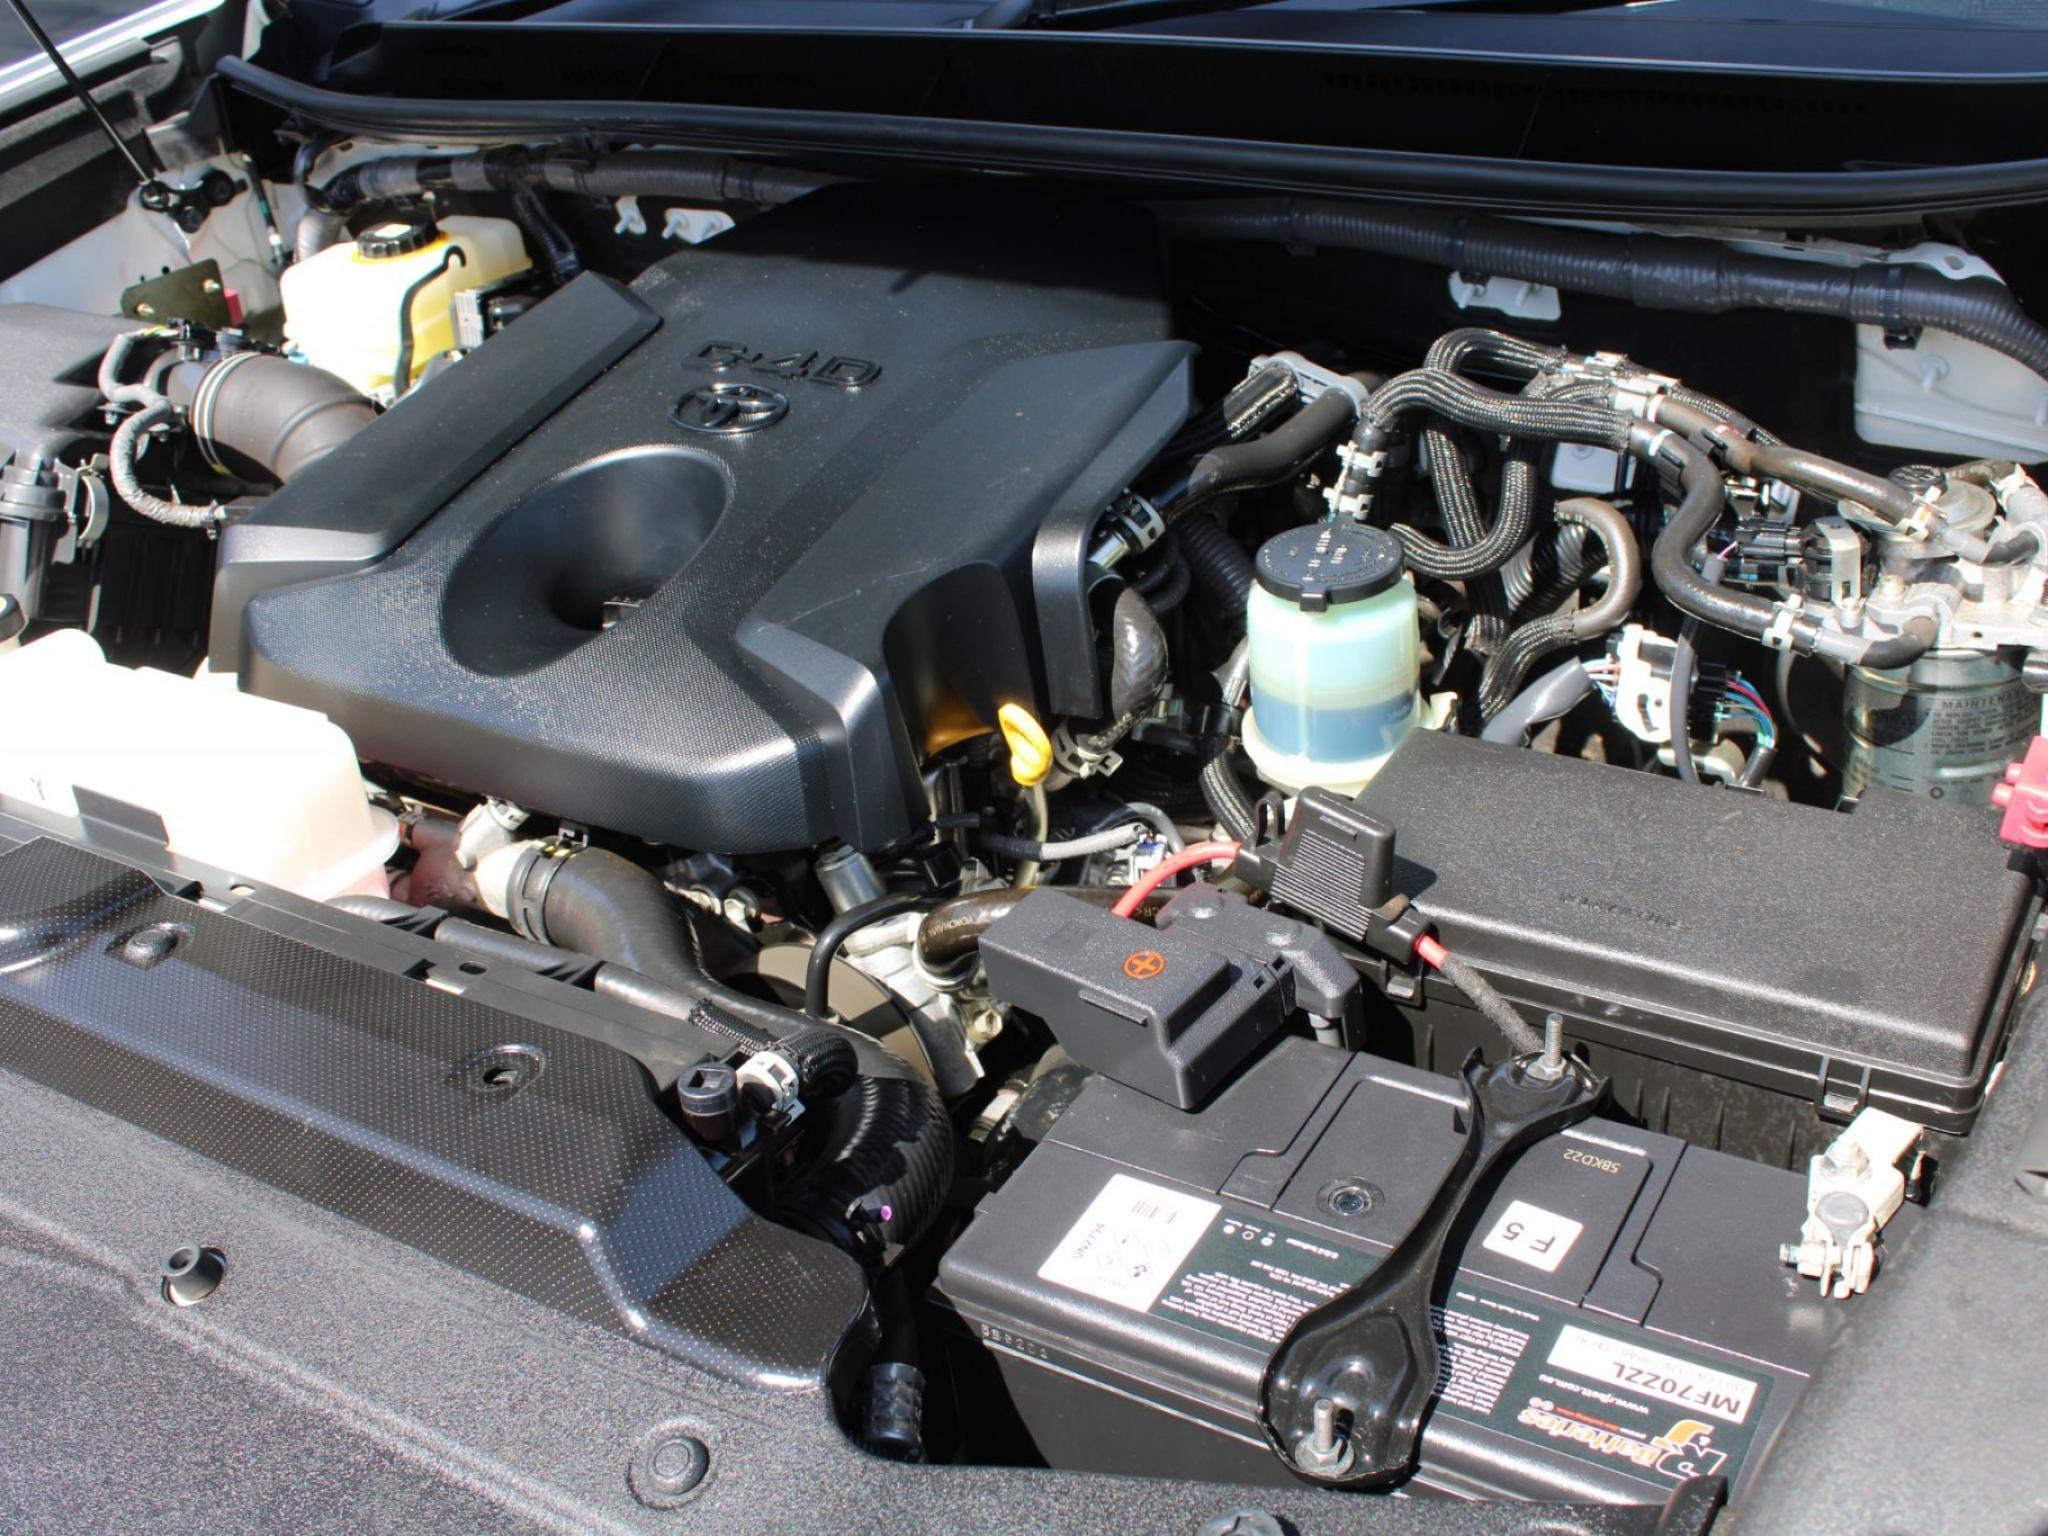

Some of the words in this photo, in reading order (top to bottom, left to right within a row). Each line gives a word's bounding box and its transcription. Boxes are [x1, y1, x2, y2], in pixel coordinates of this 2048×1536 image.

[1502, 1222, 1525, 1241] 5
[1529, 1236, 1556, 1254] F
[1613, 1361, 1741, 1414] MF70ZZL
[1517, 1408, 1663, 1468] Batteries
